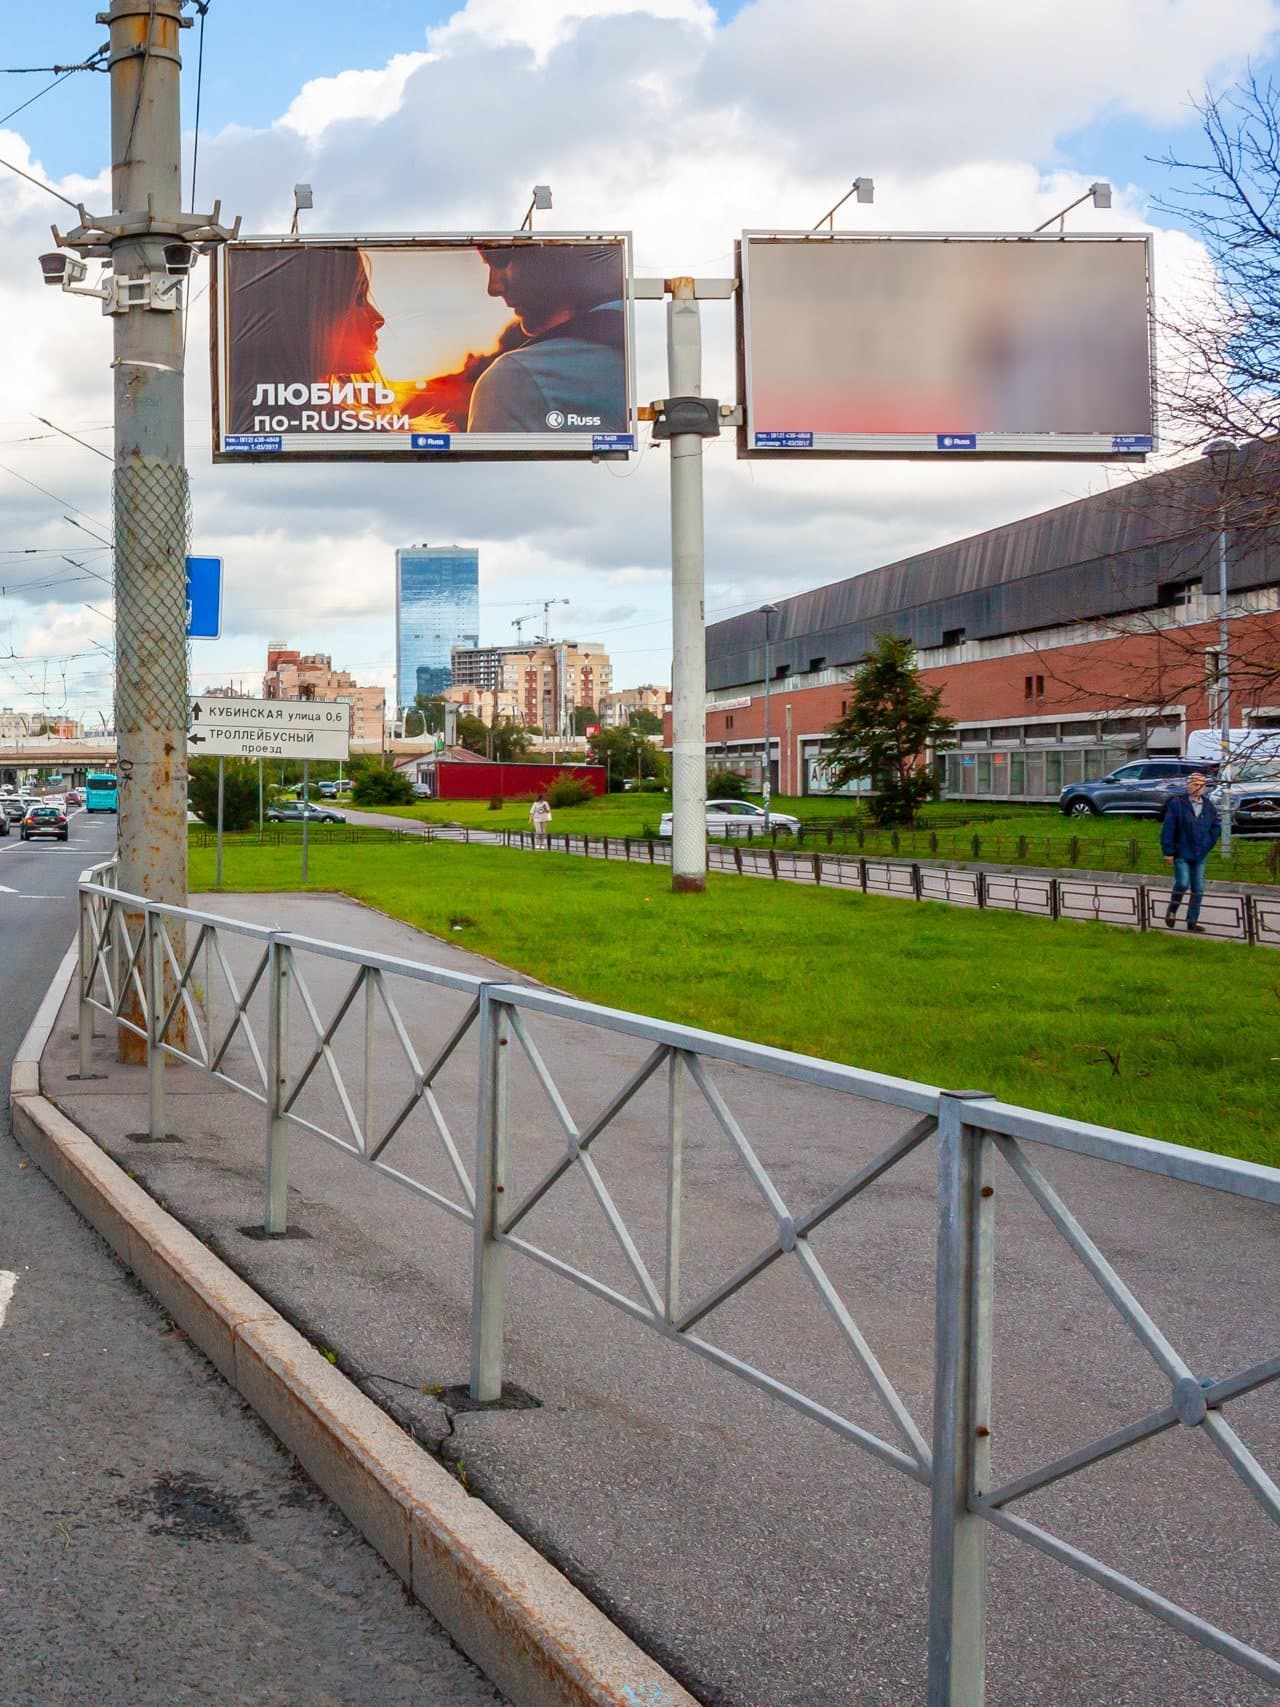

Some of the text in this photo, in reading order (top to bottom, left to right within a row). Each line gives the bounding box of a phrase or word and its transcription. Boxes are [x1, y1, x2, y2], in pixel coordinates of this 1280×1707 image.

[252, 382, 395, 406] ЛЮБИТЬ
[253, 410, 409, 431] по-RUSSки
[567, 414, 601, 426] Russ
[209, 707, 342, 722] КУБИНСКАЯ улица 0.6
[209, 729, 314, 742] ТРОЛЛЕЙБУСНЫЙ
[241, 744, 282, 754] проезд
